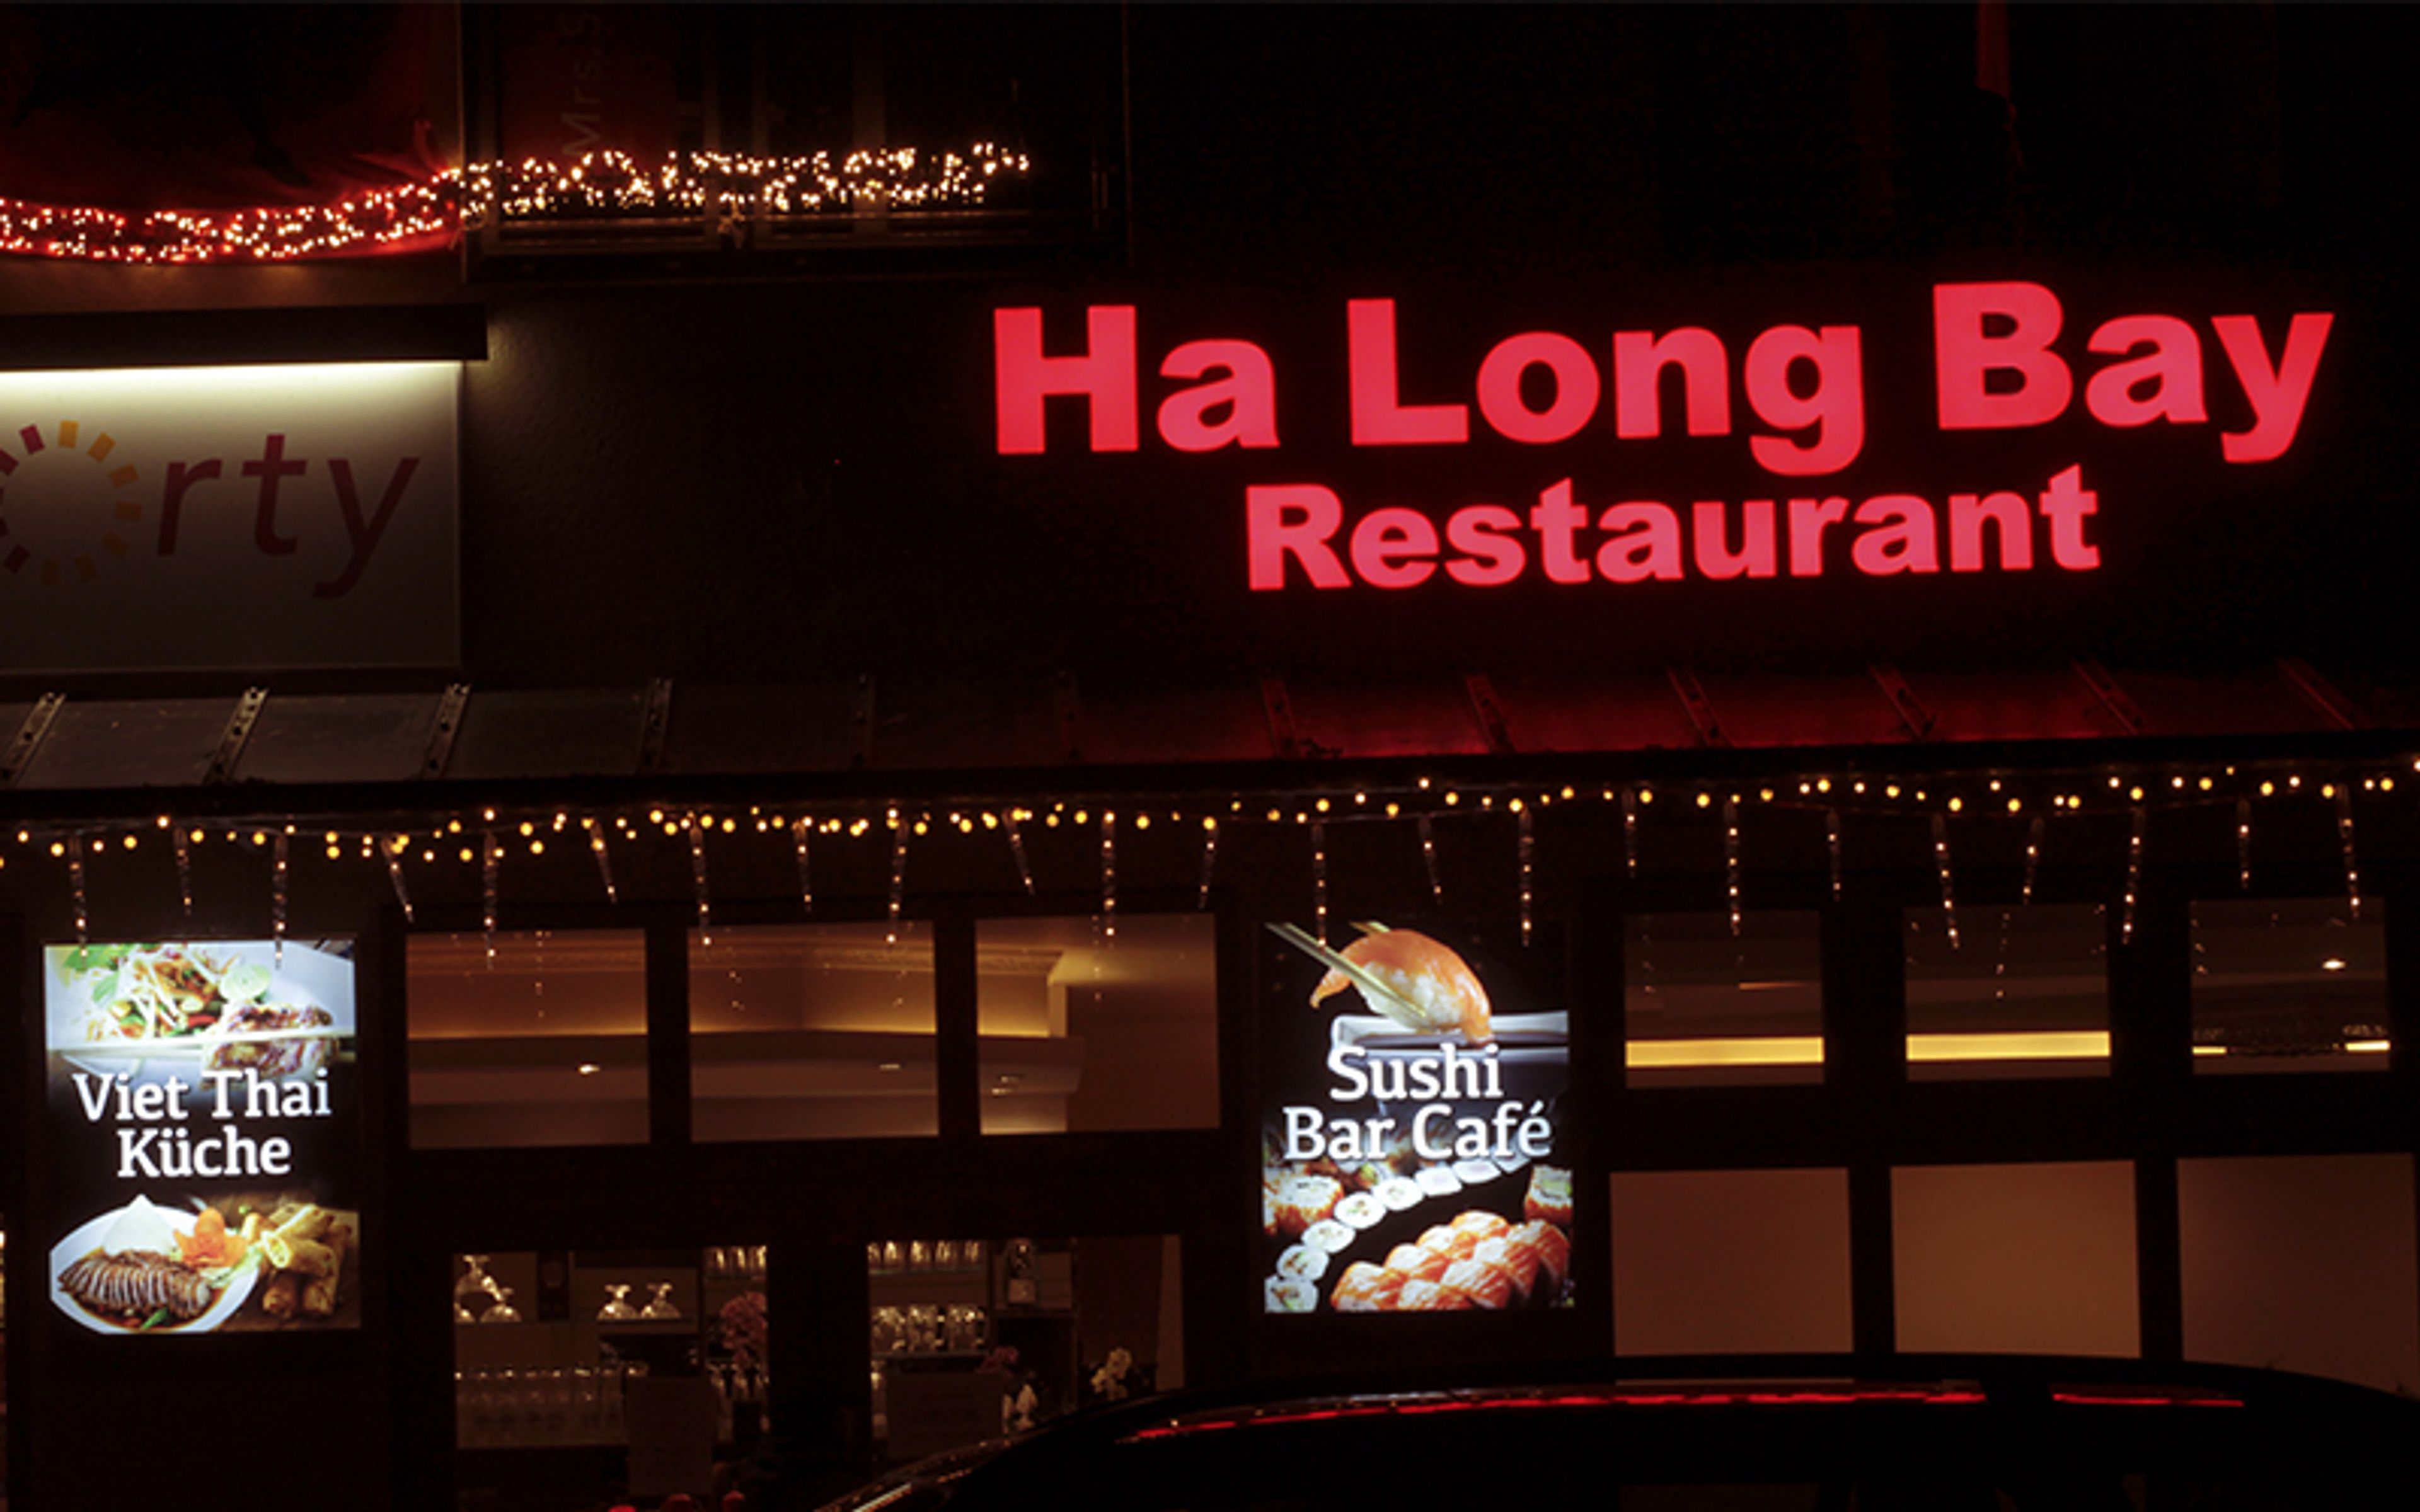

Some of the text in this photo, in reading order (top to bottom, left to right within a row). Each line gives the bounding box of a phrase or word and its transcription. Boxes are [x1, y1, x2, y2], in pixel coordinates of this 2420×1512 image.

[993, 280, 2336, 478] Ha Long Bay
[1245, 462, 2102, 592] Restaurant
[71, 1067, 331, 1122] Viet Thai
[1327, 1042, 1504, 1101] Sushi
[116, 1124, 292, 1178] Küche
[1282, 1099, 1552, 1160] Bar Café
